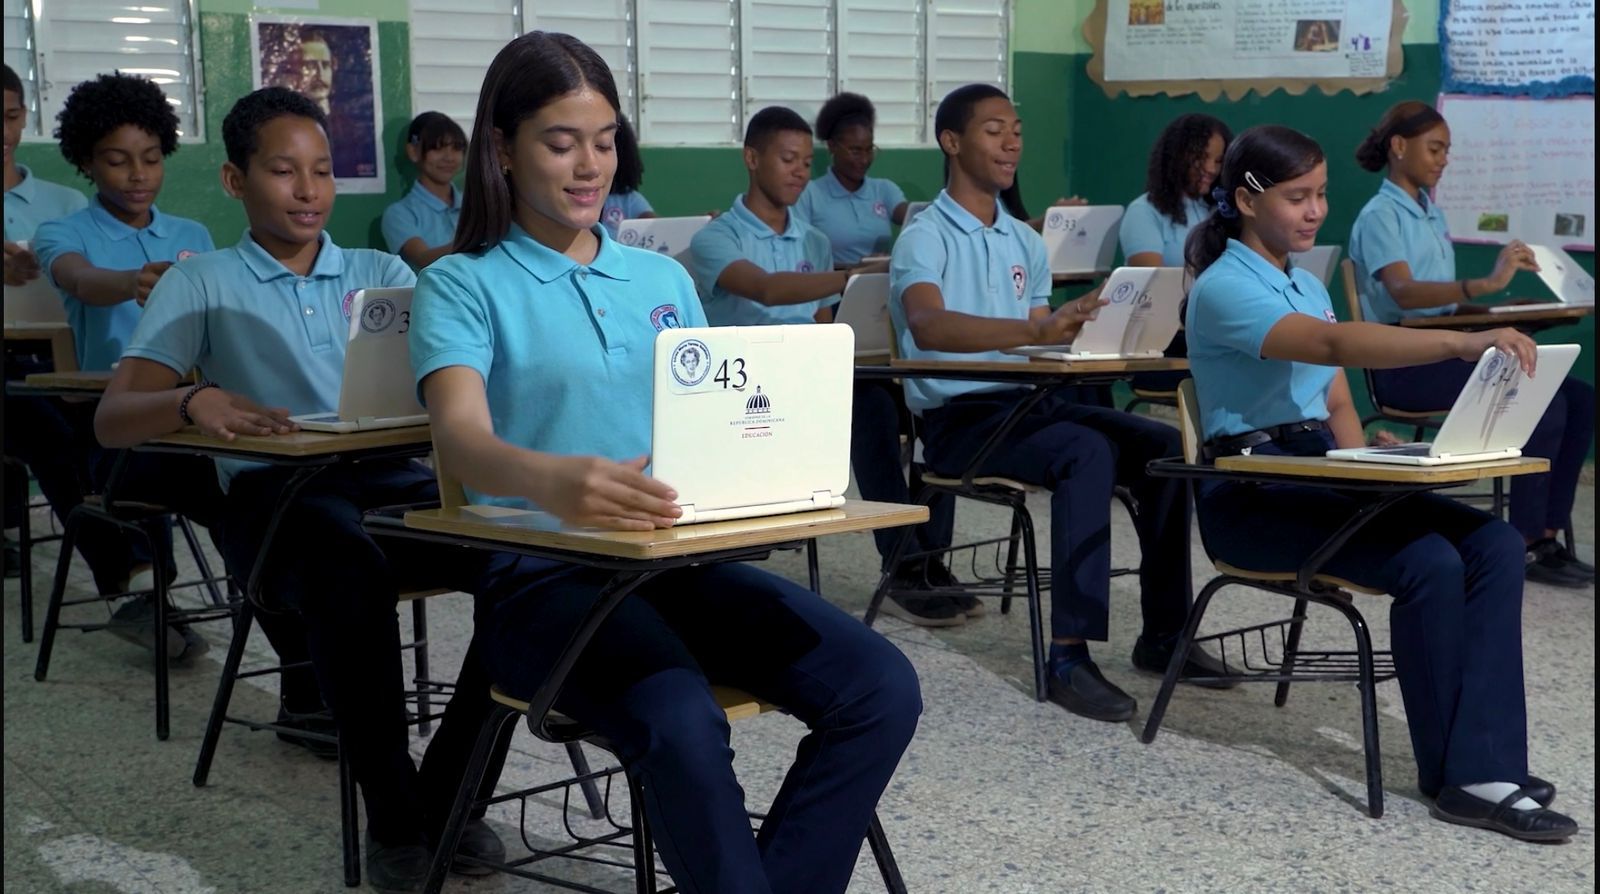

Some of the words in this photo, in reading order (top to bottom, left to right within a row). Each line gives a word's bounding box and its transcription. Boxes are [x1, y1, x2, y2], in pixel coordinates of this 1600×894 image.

[1061, 218, 1077, 232] 33
[638, 235, 655, 249] 45
[1130, 288, 1151, 306] 16
[713, 357, 748, 390] 43
[1492, 366, 1518, 387] 34
